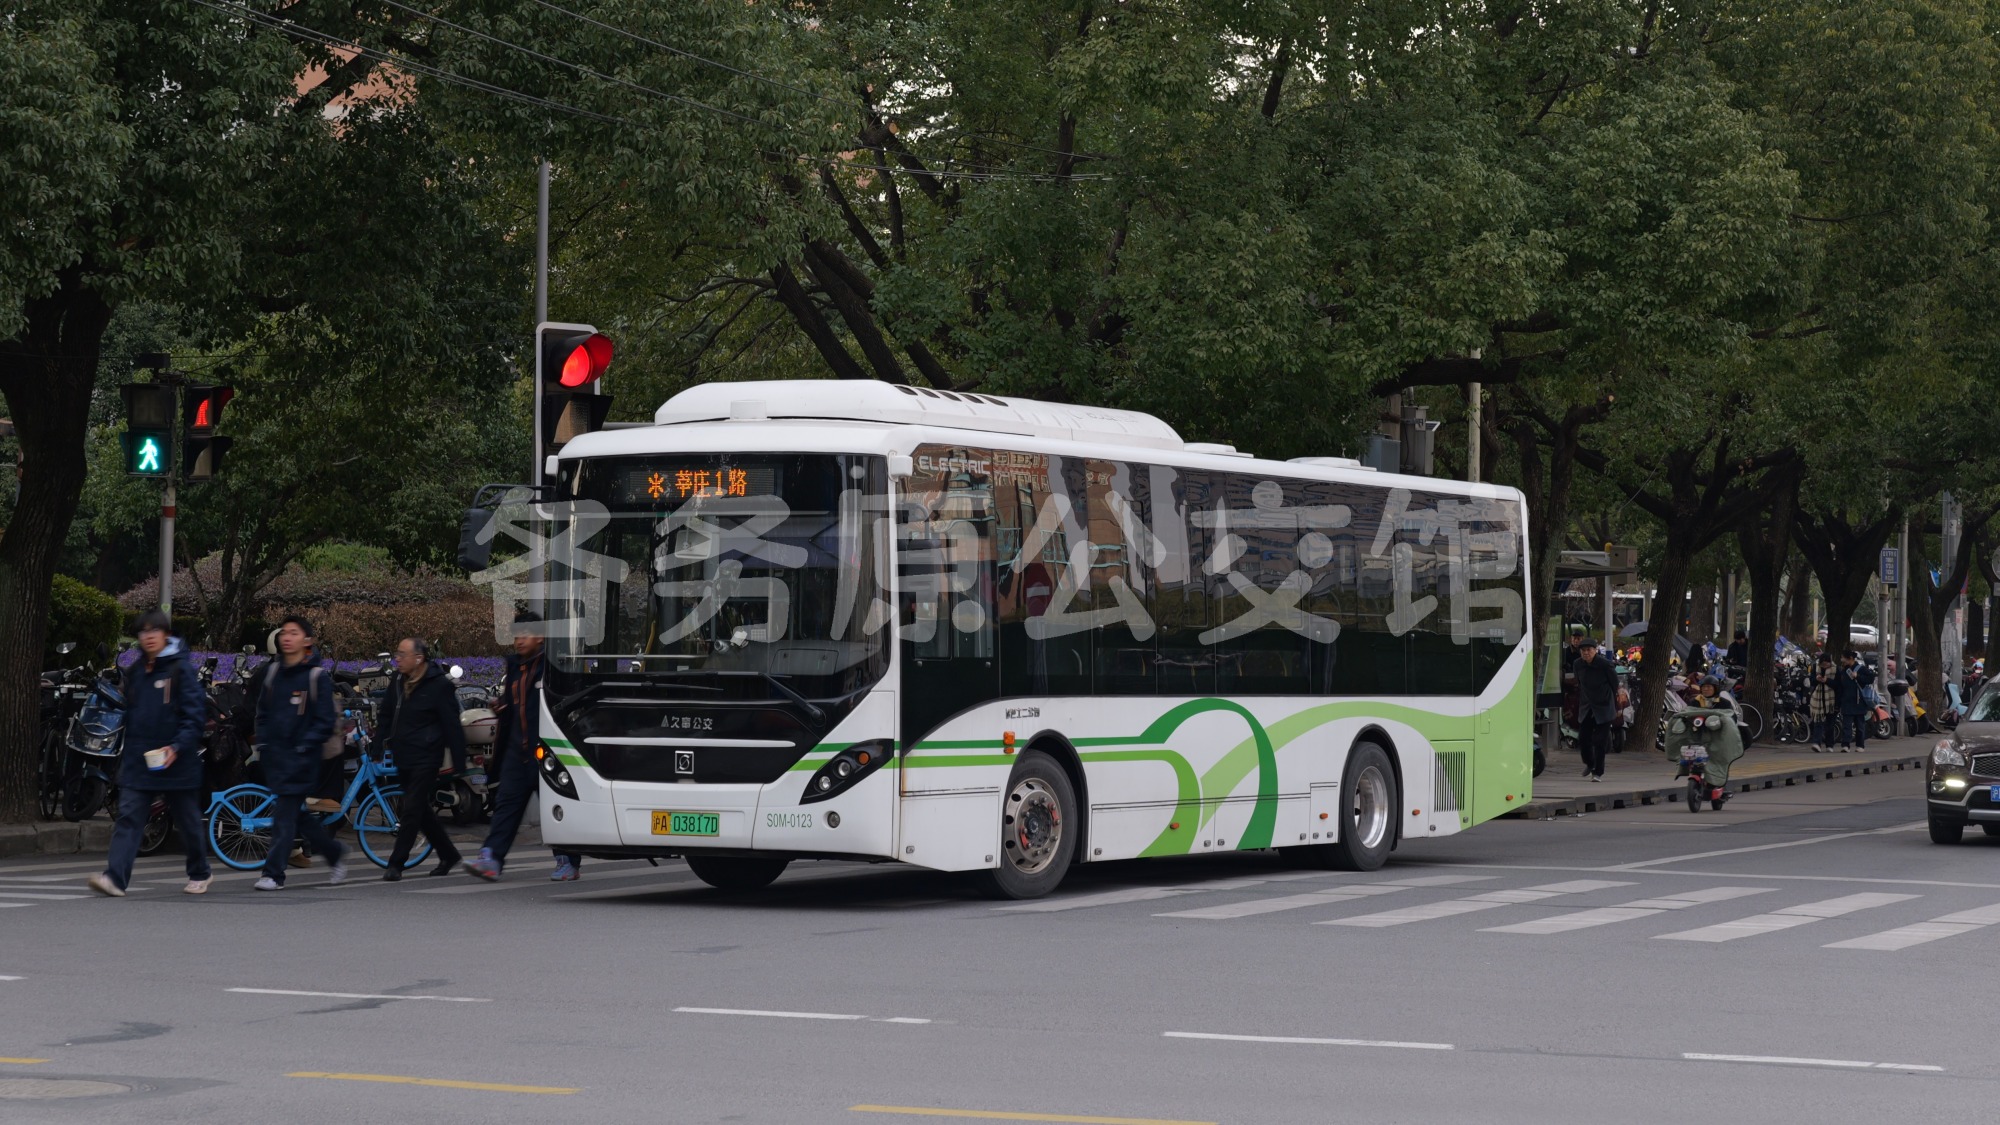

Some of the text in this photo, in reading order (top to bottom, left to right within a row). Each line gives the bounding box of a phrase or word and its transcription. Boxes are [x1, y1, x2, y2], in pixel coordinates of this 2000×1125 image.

[918, 455, 991, 475] ELECTRIC
[675, 468, 748, 498] 莘庄1路
